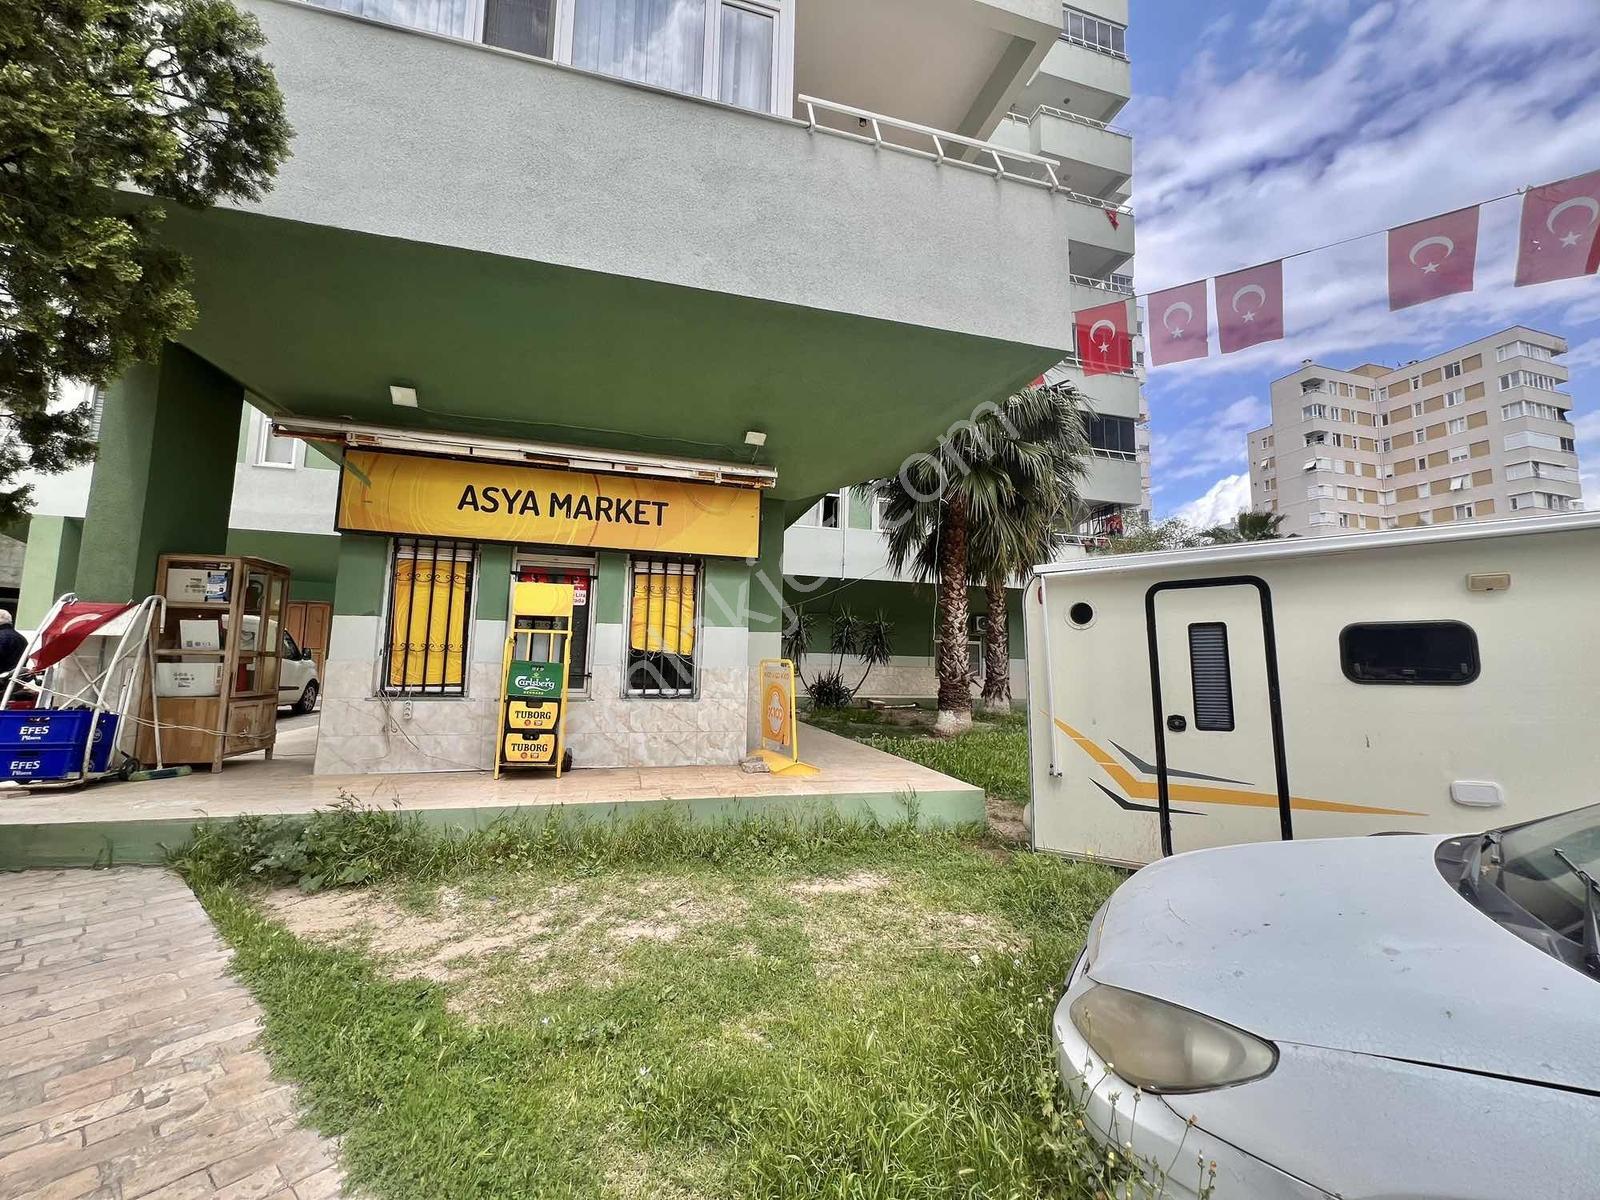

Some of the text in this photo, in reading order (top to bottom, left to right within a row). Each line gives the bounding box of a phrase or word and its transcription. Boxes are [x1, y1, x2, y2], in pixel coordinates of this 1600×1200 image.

[457, 484, 669, 527] ASYA MARKET
[515, 675, 555, 690] Carlsberg
[514, 710, 552, 720] TUBORG
[19, 725, 50, 735] EFES
[511, 743, 548, 752] TUBORG
[10, 760, 41, 770] EFES
